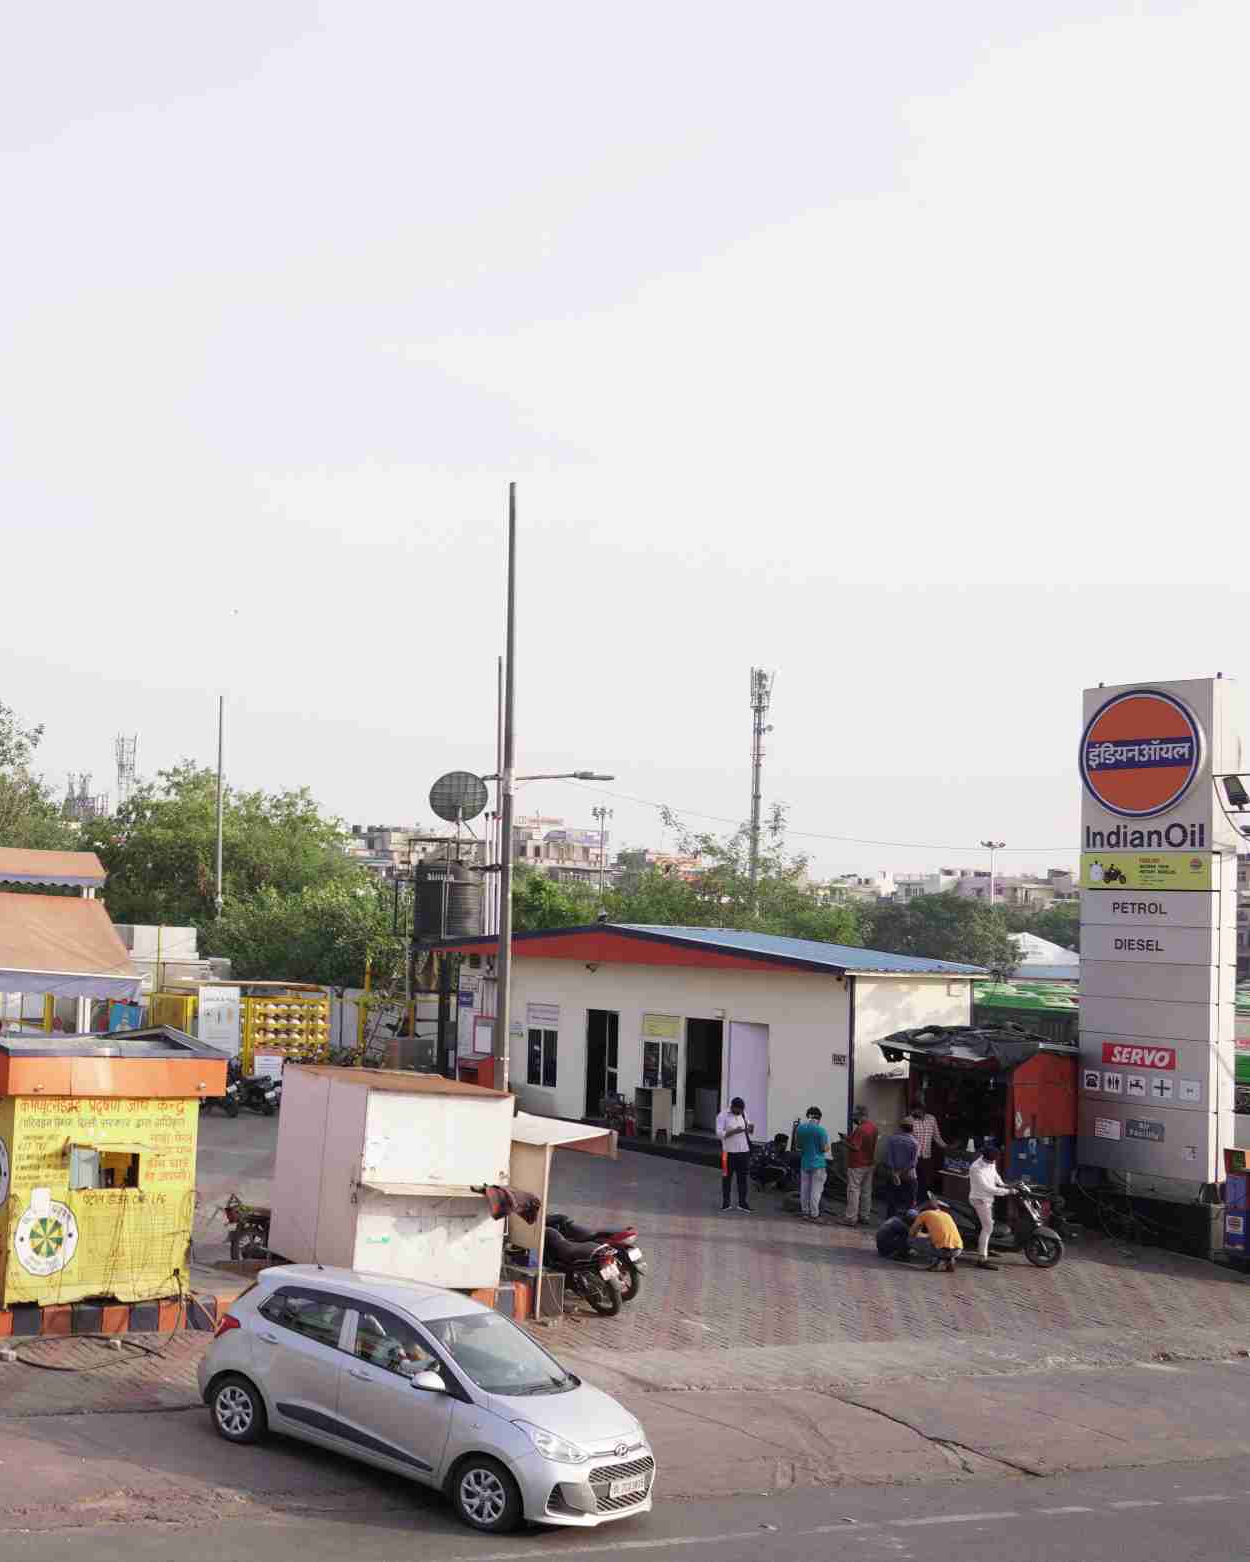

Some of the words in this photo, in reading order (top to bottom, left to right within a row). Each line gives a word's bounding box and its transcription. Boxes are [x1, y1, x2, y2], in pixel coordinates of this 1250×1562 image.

[1087, 739, 1191, 768] इंडियनऑयल
[1085, 822, 1205, 849] IndianOil
[1112, 902, 1168, 915] PETROL
[1114, 938, 1165, 952] DIESEL
[1111, 1045, 1170, 1067] SERVO
